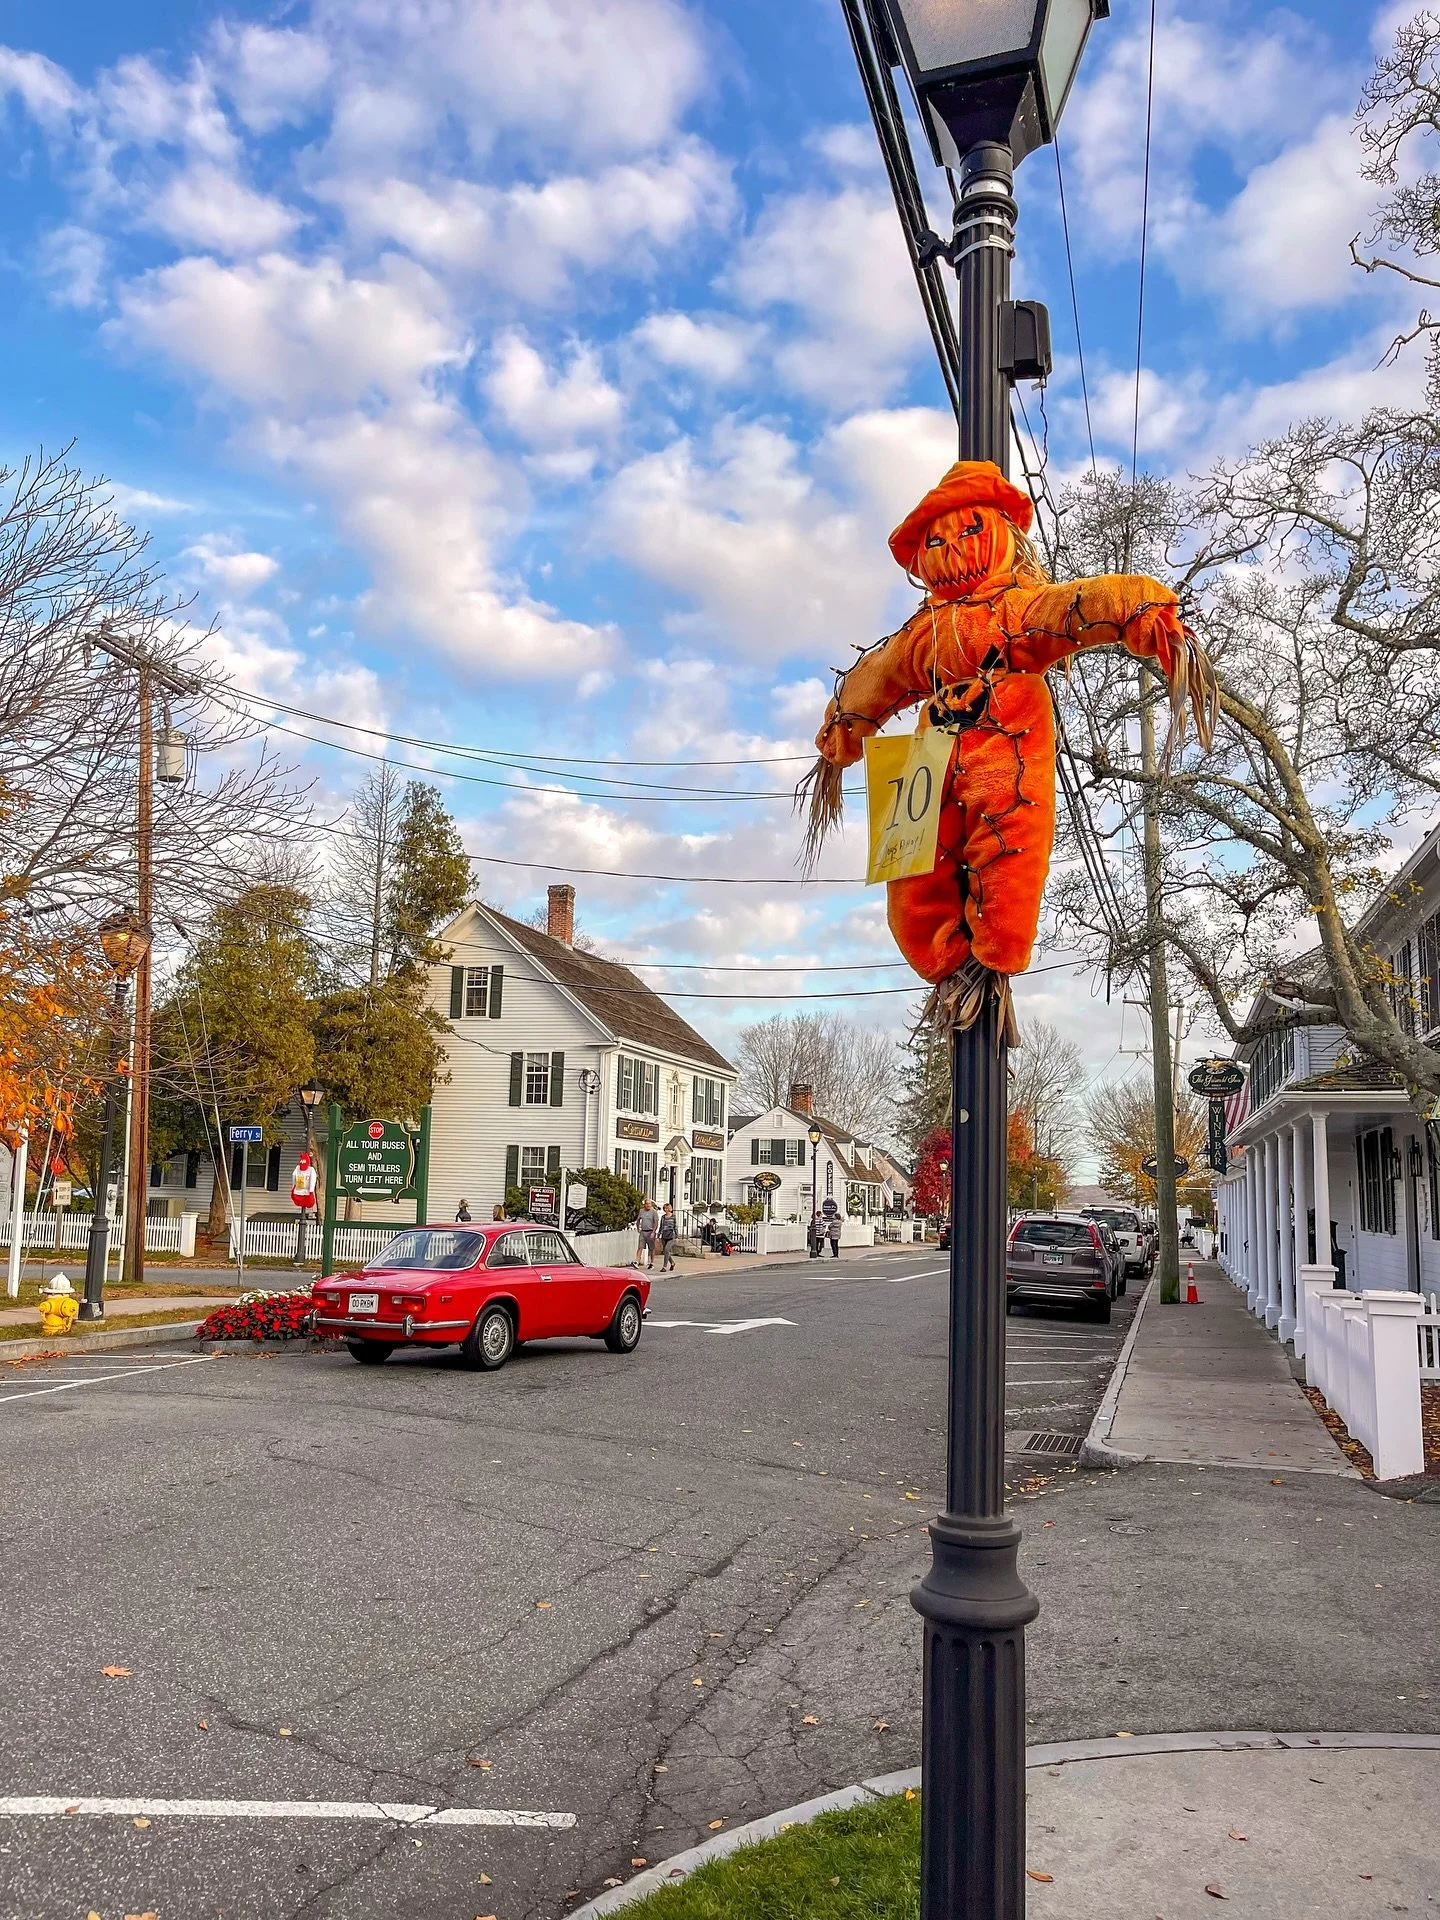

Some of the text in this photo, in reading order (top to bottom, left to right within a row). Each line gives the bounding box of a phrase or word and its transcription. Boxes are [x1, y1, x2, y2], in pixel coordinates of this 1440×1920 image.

[886, 765, 932, 831] 10
[1211, 1107, 1222, 1138] WINE
[231, 1128, 253, 1140] Ferry
[346, 1141, 406, 1150] ALL TOUR BUSES
[367, 1152, 382, 1161] AND
[1214, 1142, 1222, 1165] BAR
[348, 1163, 401, 1173] SEMI TRAILERS
[345, 1174, 403, 1185] TURN LEFT HERE
